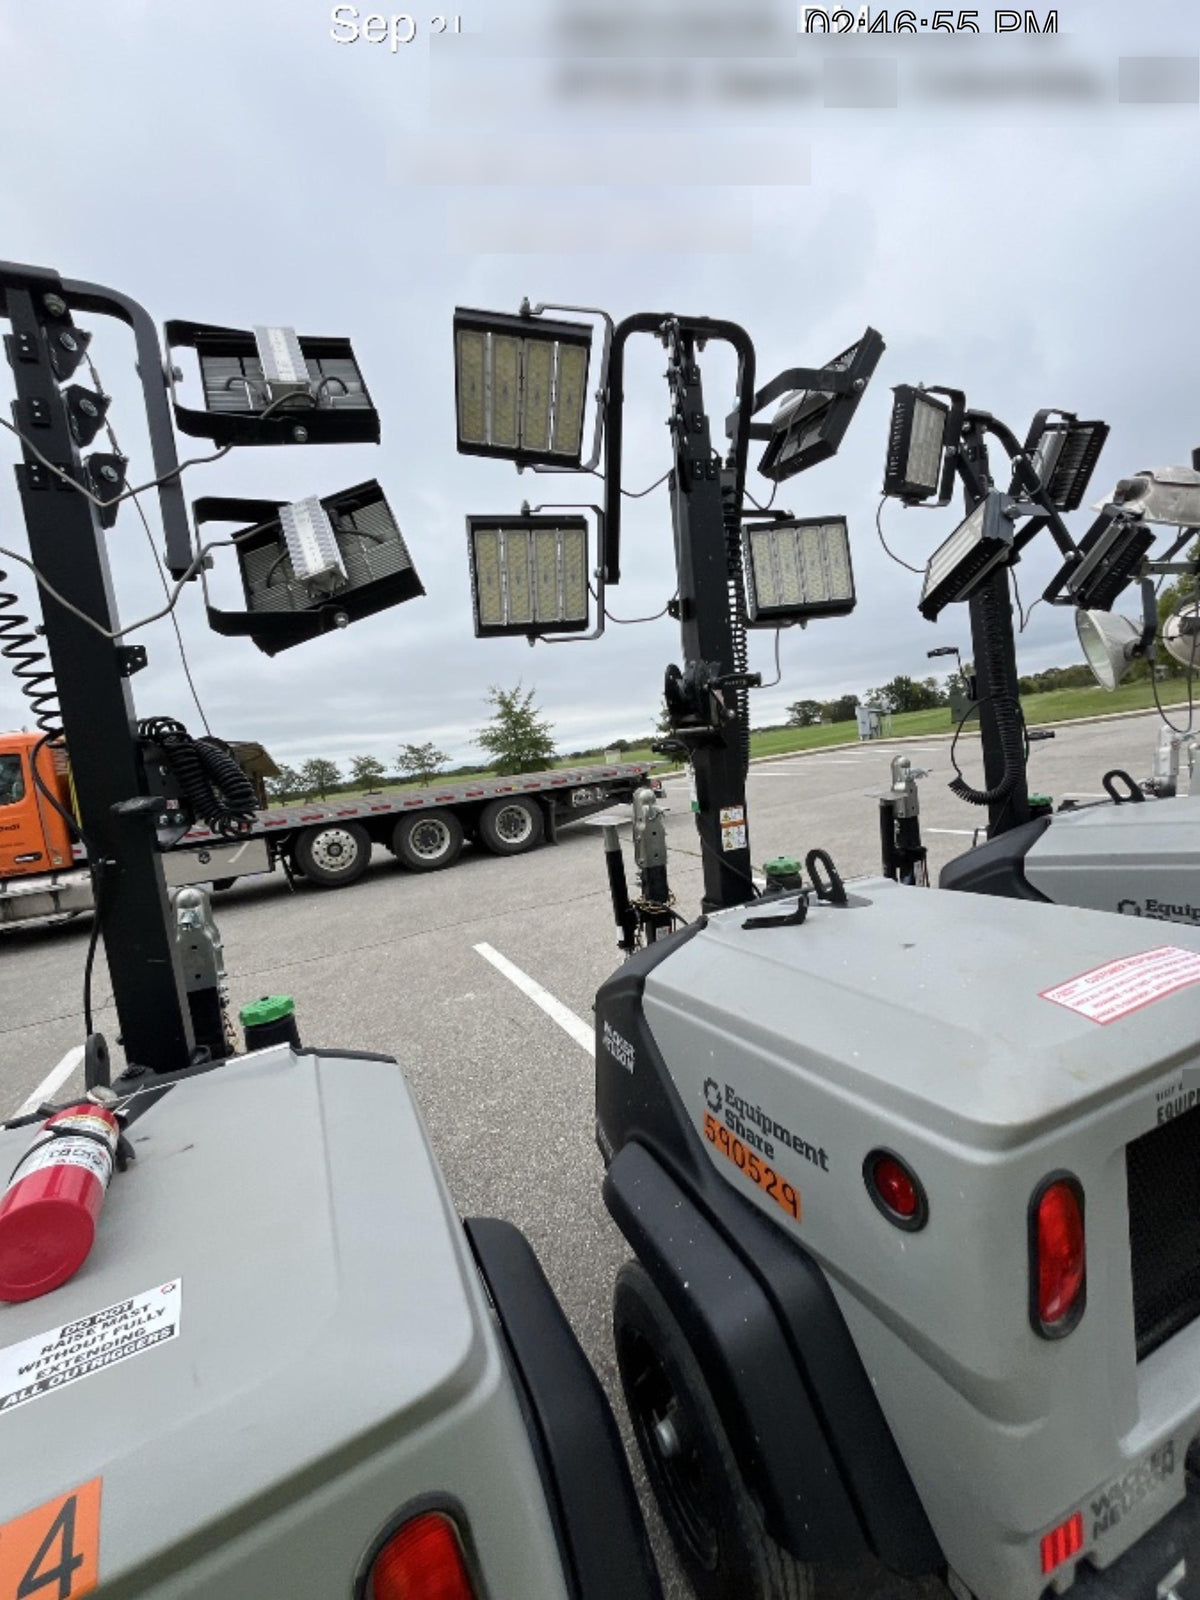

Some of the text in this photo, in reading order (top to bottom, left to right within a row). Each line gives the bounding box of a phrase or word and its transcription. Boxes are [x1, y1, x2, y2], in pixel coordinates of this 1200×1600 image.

[725, 1084, 830, 1173] Equipment
[725, 1106, 775, 1161] Share
[705, 1115, 798, 1219] 590529
[2, 1325, 173, 1408] ALL OUTRIGGERS
[18, 1307, 166, 1376] WITHOUT FULLY
[35, 1327, 147, 1380] EXTENDING
[40, 1303, 152, 1356] RAISE MAST
[17, 1495, 84, 1600] 4
